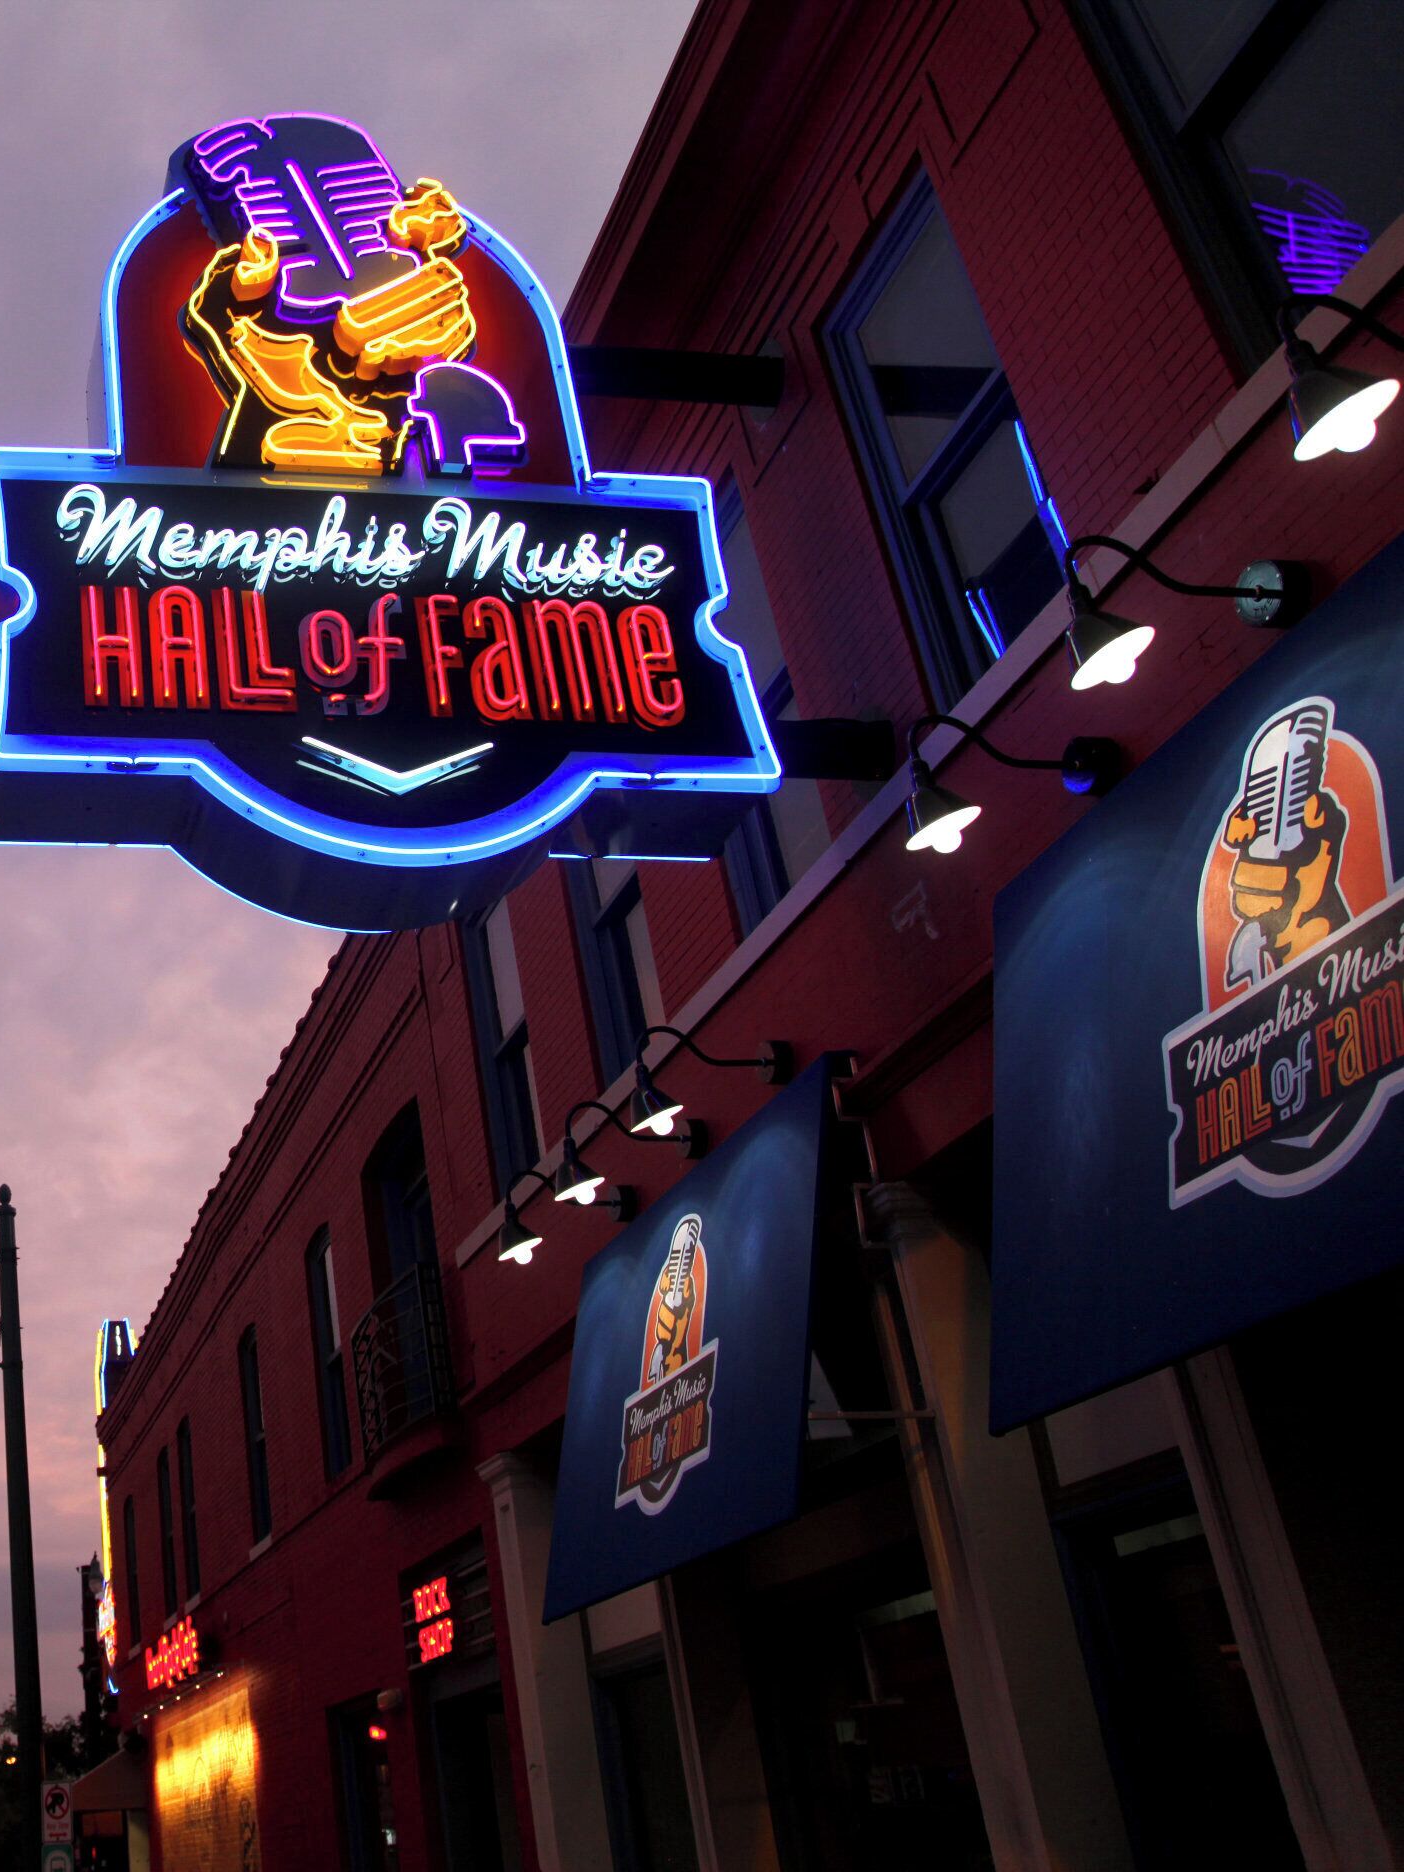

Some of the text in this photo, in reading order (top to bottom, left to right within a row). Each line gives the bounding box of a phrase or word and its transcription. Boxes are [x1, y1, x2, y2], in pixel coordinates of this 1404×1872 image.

[57, 483, 676, 596] Memphis Music
[82, 585, 686, 731] HALL of Fame
[1186, 984, 1319, 1087] Memphis
[1196, 980, 1404, 1166] HALL of Fam
[630, 1372, 706, 1437] Memphis Music
[651, 1420, 669, 1471] of
[665, 1400, 704, 1464] Fame
[418, 1618, 454, 1664] SHOP
